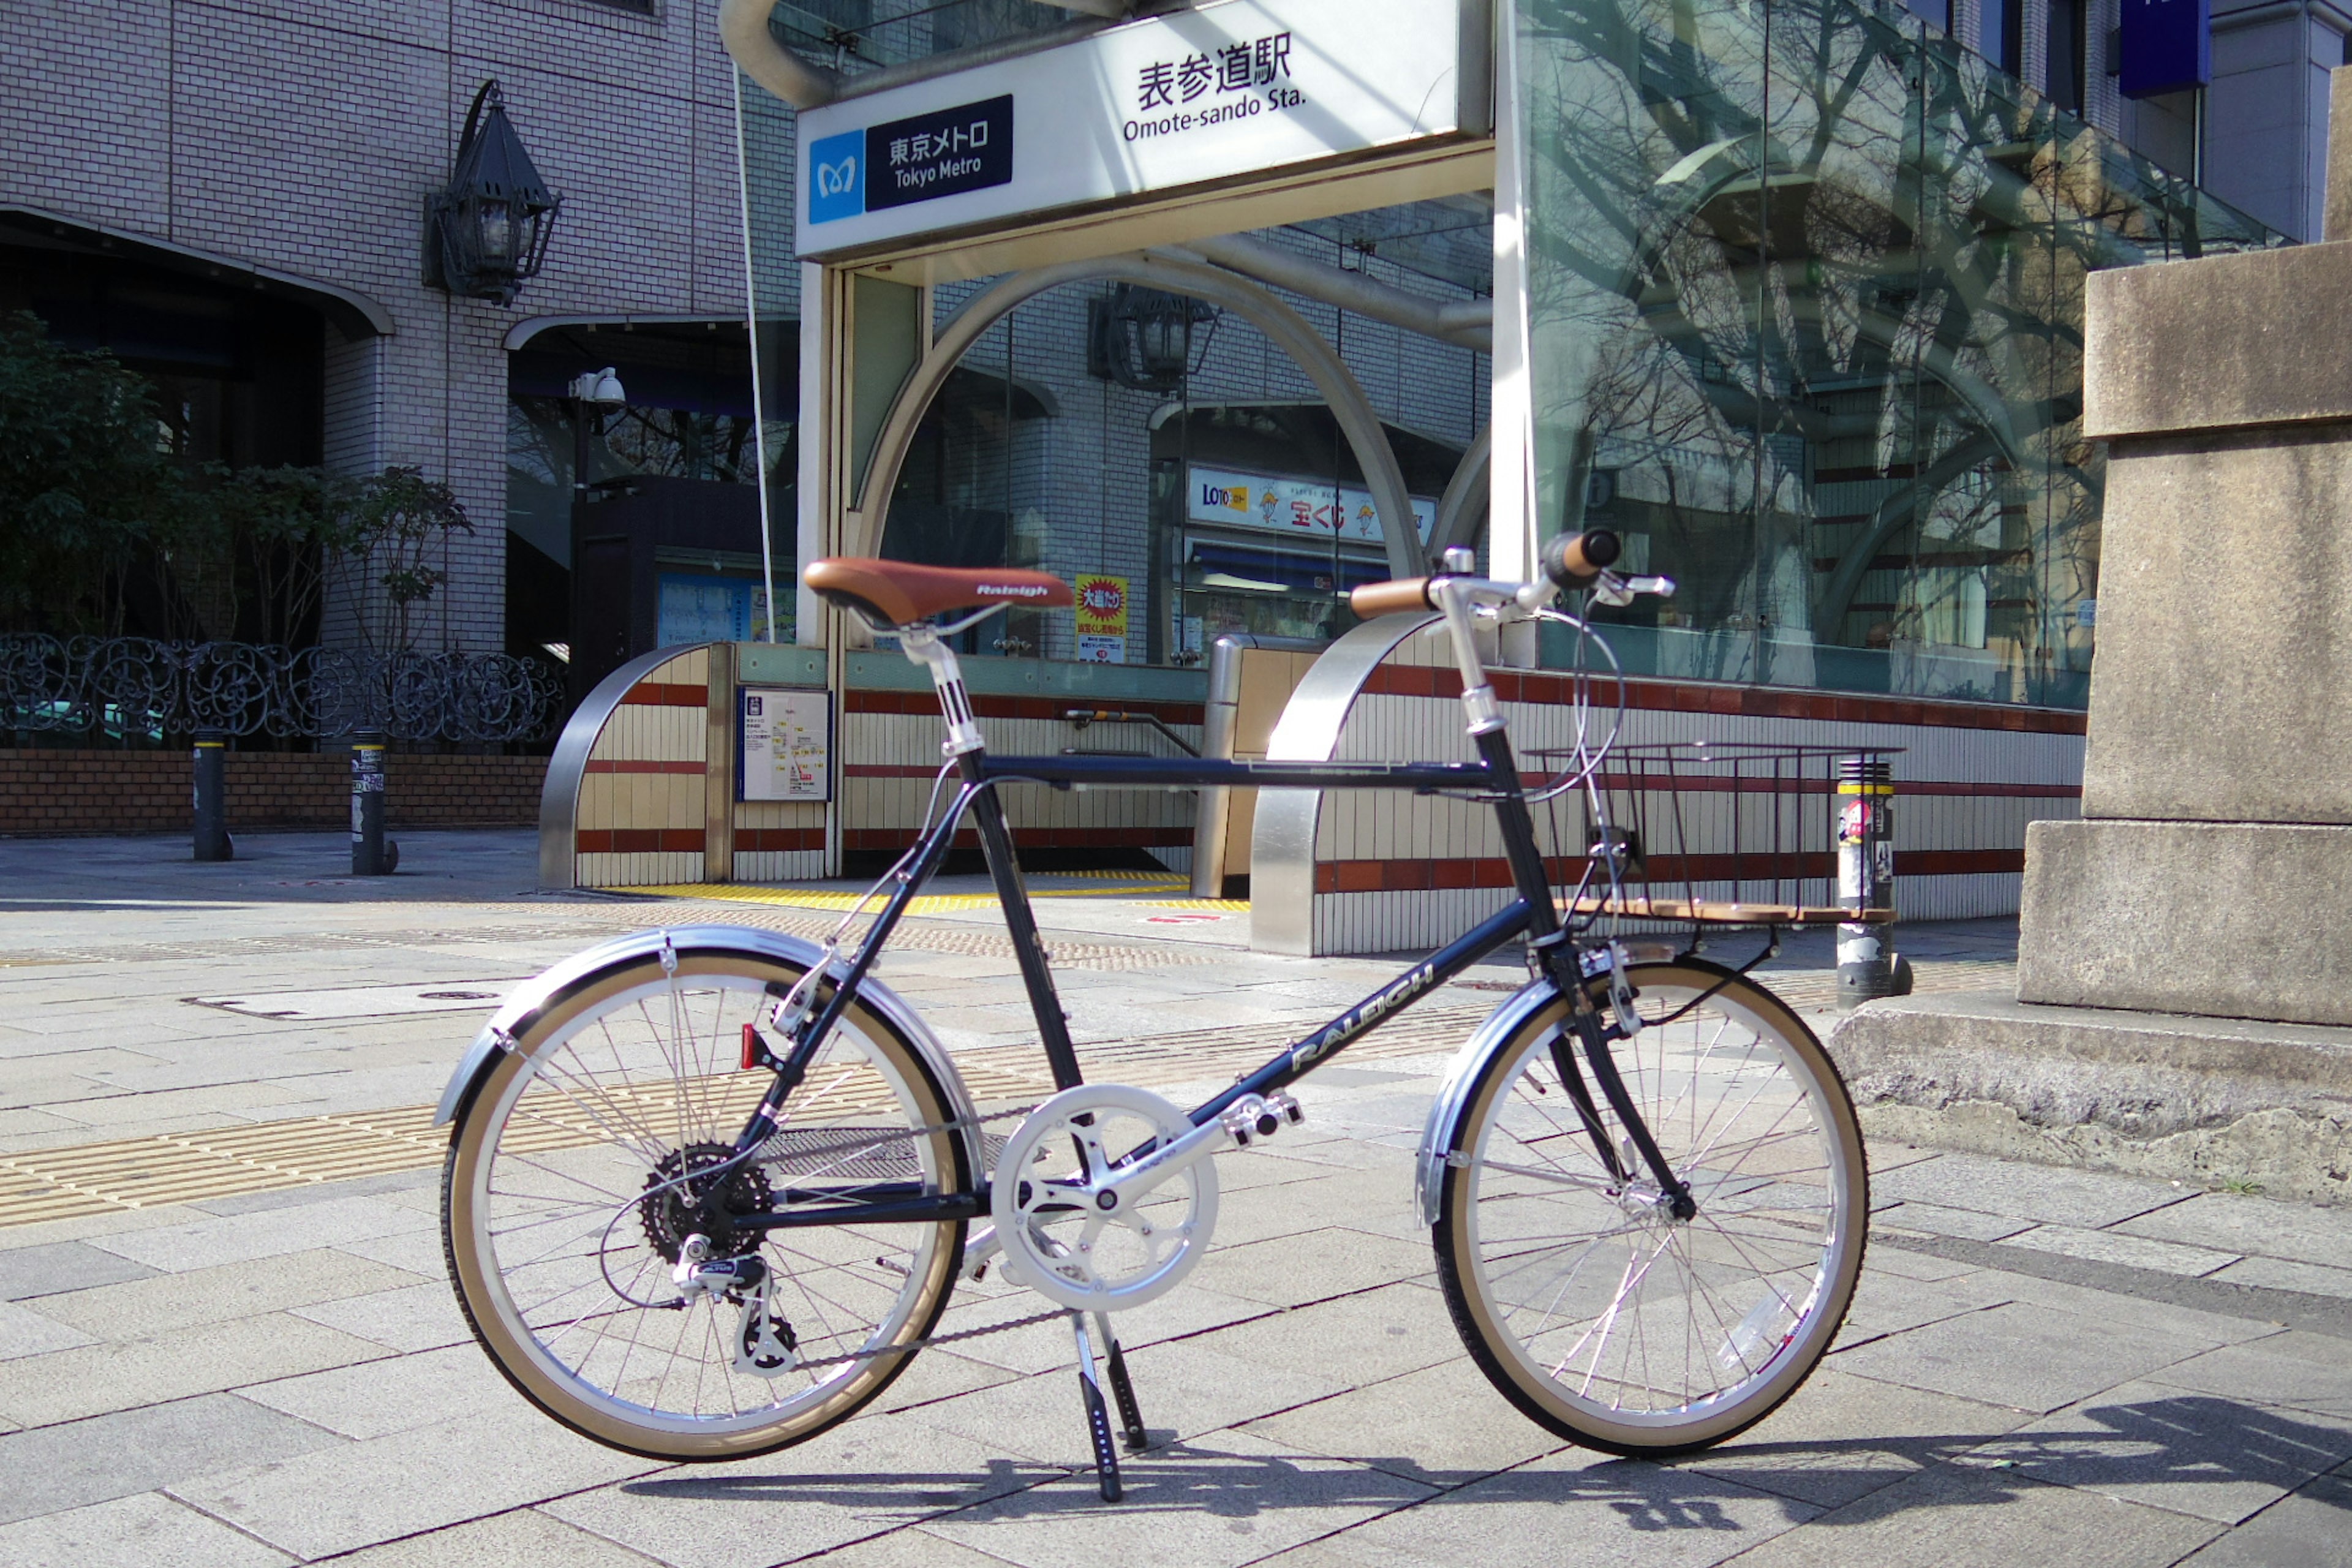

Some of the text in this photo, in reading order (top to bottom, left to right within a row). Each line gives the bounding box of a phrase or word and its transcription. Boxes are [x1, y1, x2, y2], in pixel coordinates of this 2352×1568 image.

[1138, 31, 1291, 112] 表参道駅
[1123, 88, 1306, 141] Omote-sando Sta.
[889, 120, 989, 167] 東京メトロ
[895, 157, 981, 189] Tokyo Metro
[1203, 483, 1229, 506] LOTO
[1290, 500, 1345, 529] 宝くじ
[976, 584, 1049, 598] Raleigh
[1084, 589, 1120, 609] 大当たり
[1292, 962, 1434, 1072] RALEIGH
